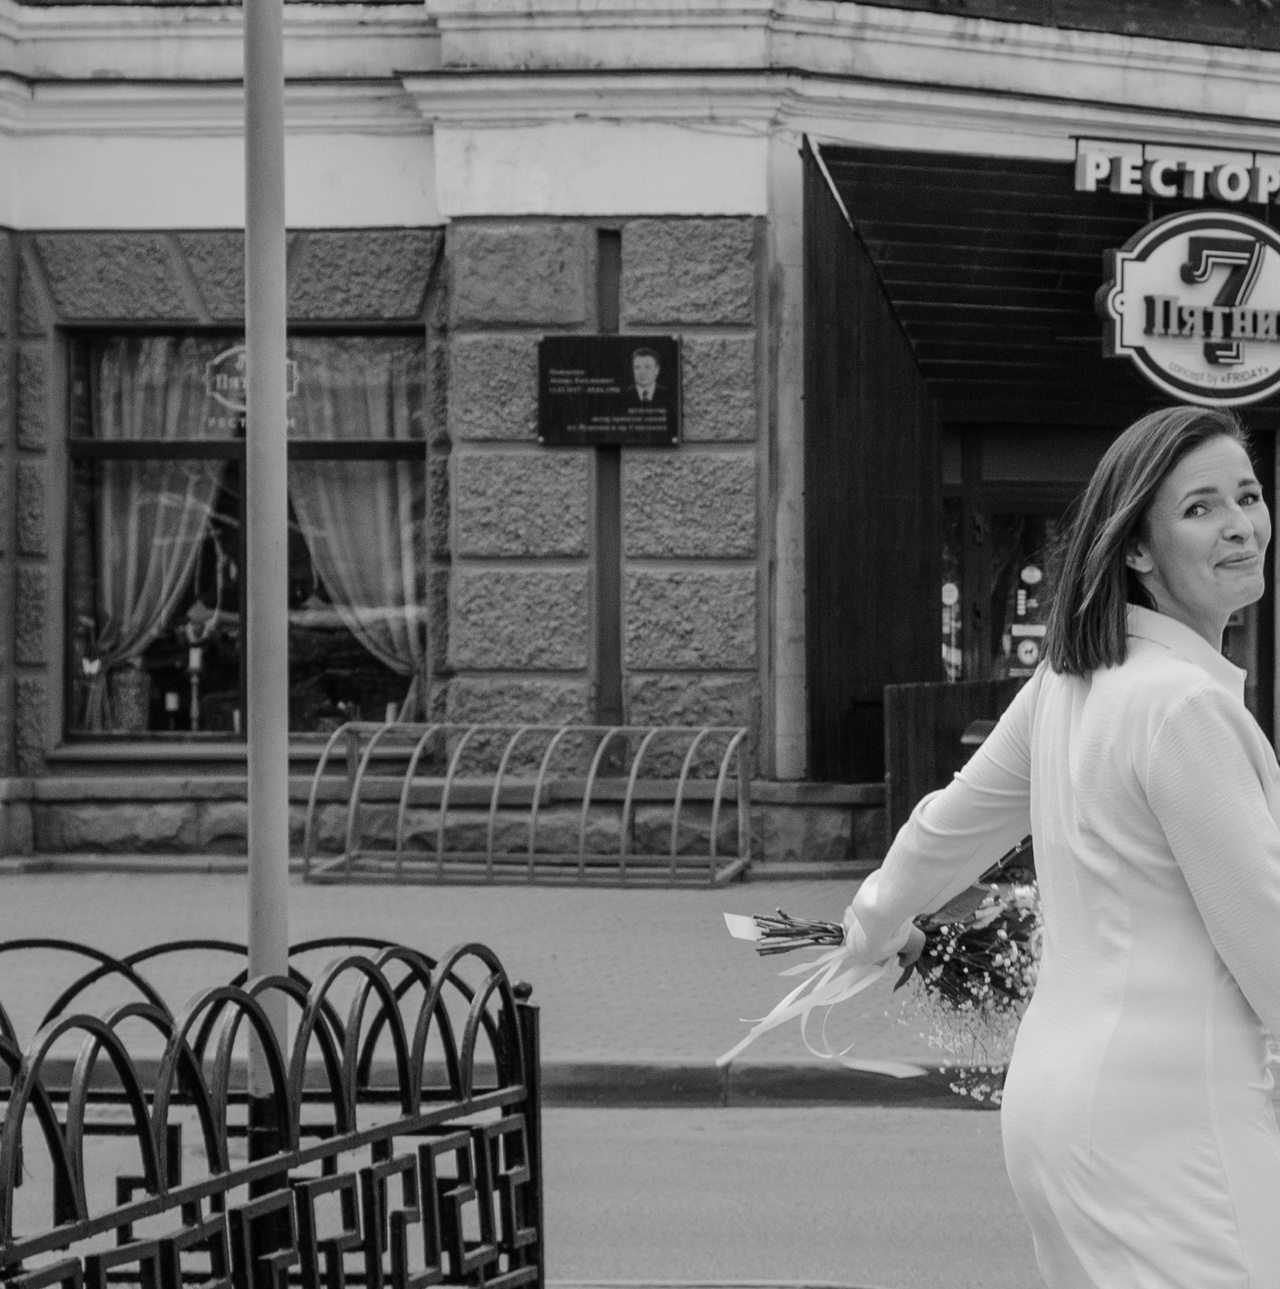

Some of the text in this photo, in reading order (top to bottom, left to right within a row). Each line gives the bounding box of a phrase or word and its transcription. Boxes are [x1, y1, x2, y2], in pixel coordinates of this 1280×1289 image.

[1180, 235, 1267, 366] 7
[1167, 361, 1205, 384] concept
[1207, 371, 1217, 387] by
